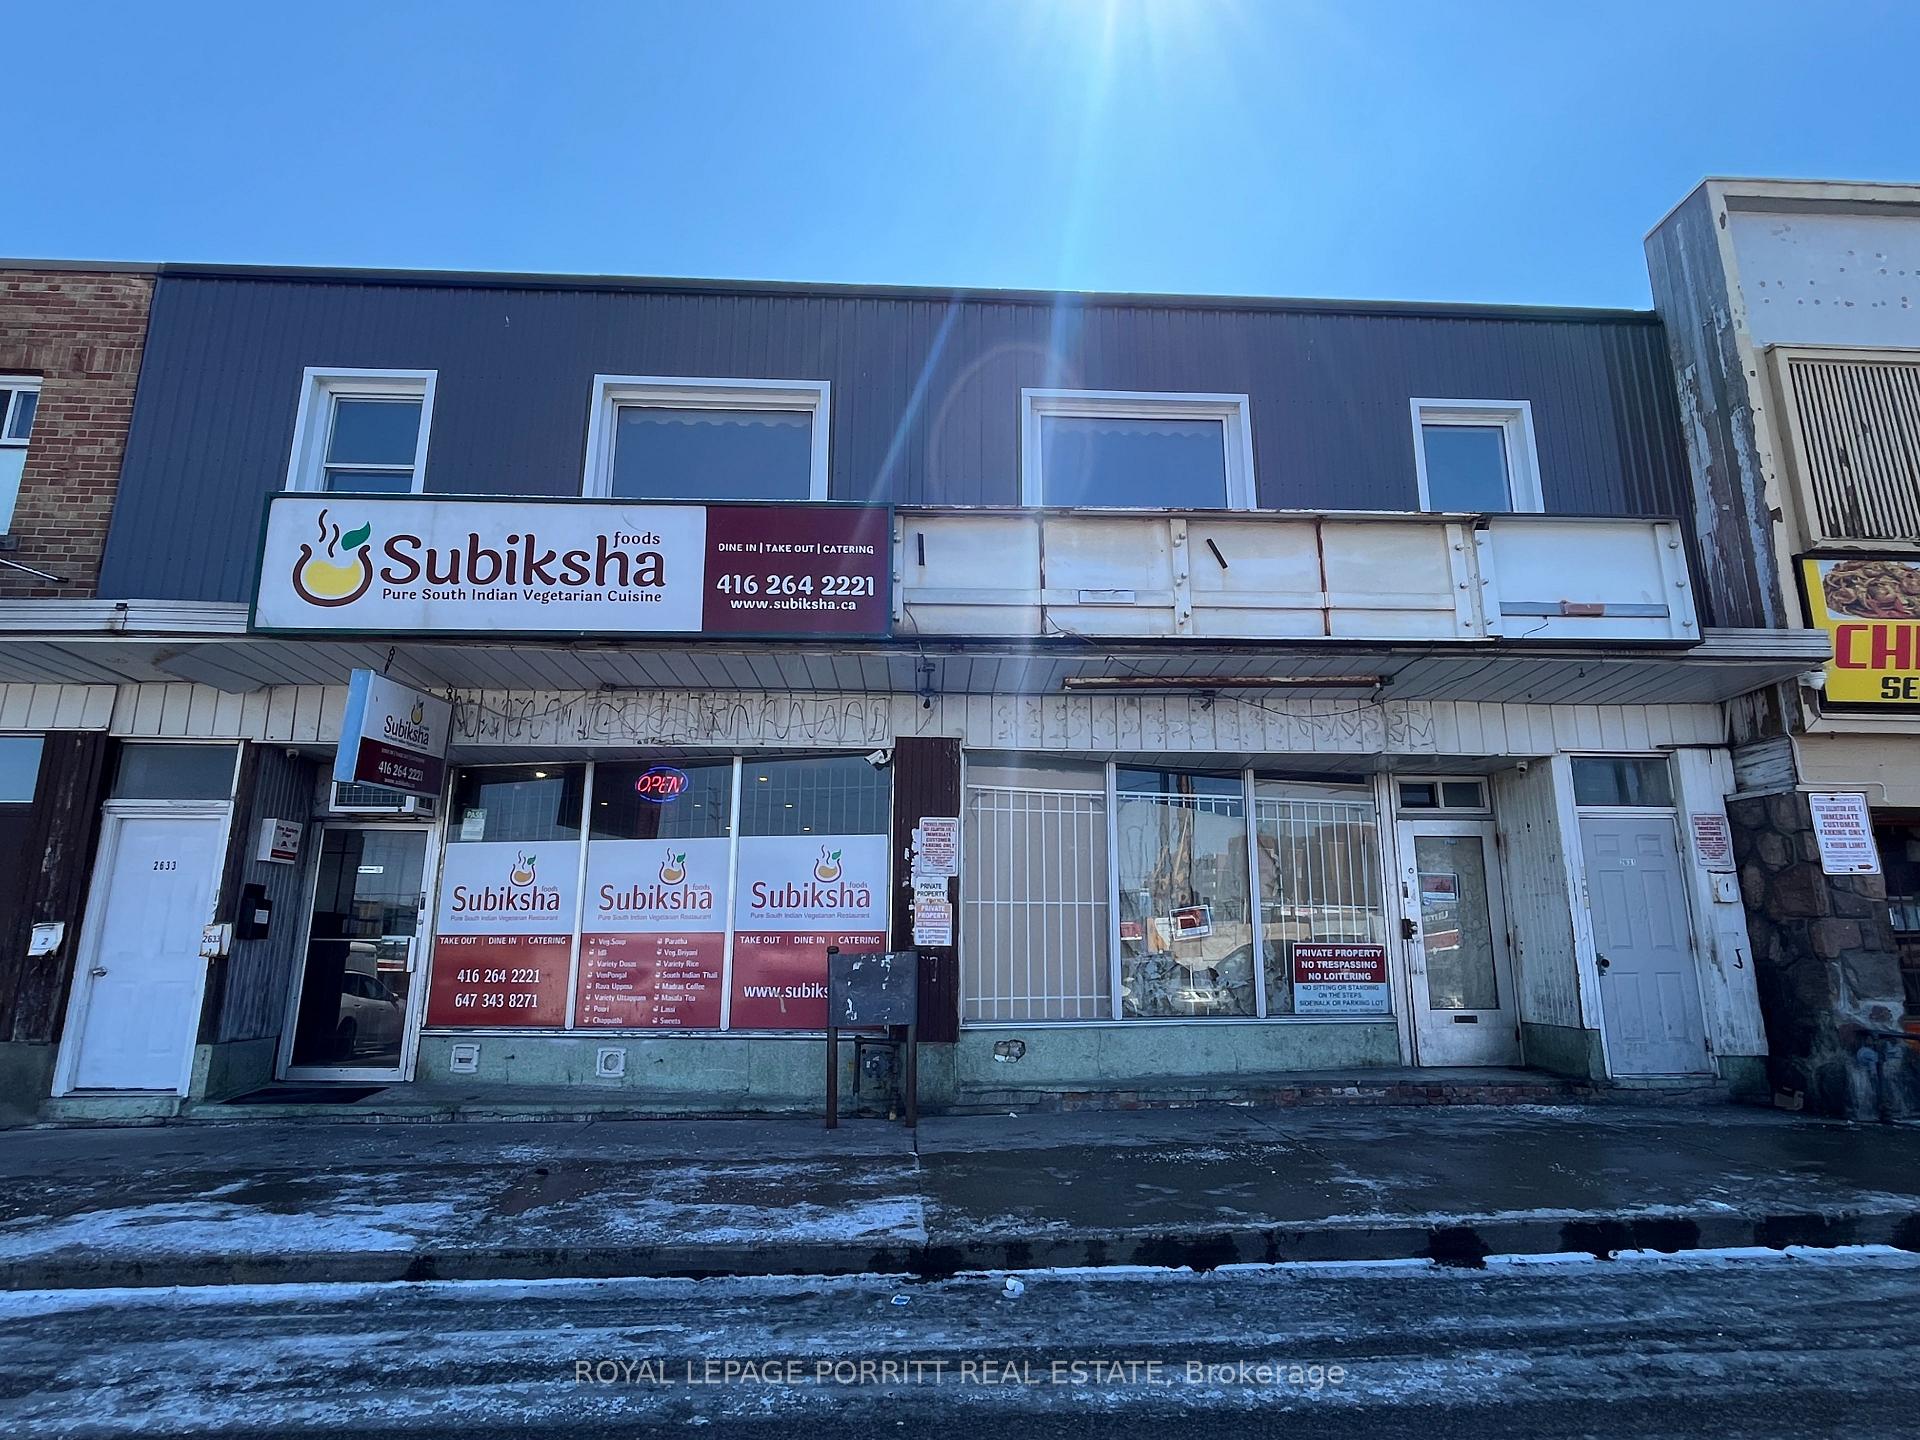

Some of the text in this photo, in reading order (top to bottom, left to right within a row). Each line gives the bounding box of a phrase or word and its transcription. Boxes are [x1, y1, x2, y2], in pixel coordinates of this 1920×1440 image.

[613, 531, 662, 549] foods
[718, 542, 874, 554] DINE IN TAKE OUT CATERING
[380, 533, 666, 587] Subiksha
[716, 574, 875, 596] 416 264 2221
[382, 588, 662, 604] Pure South Indian Vegetarian Cuisine
[730, 598, 857, 610] www.subiksha.ca
[1836, 624, 1920, 669] CH
[1881, 676, 1920, 700] SE
[384, 715, 430, 746] Subiksha
[378, 761, 424, 782] 416 264 2221
[637, 776, 684, 793] OPEN
[153, 860, 177, 871] 2633
[452, 885, 560, 911] Subiksha
[598, 884, 712, 910] Subiksha
[751, 881, 870, 908] Subiksha
[439, 936, 566, 945] TAKE OUT DINE IN CATERING
[740, 936, 880, 944] TAKE OUT DINE IN CATERING
[1296, 949, 1382, 957] PRIVATE PROPERTY
[596, 960, 617, 968] Variety
[663, 960, 685, 968] Variety
[1301, 961, 1377, 969] NO TRESPASSING
[457, 969, 540, 983] 416 264 2221
[1323, 973, 1372, 981] LOITERING
[743, 982, 828, 998] www.subiks
[455, 993, 538, 1008] 647 343 8271
